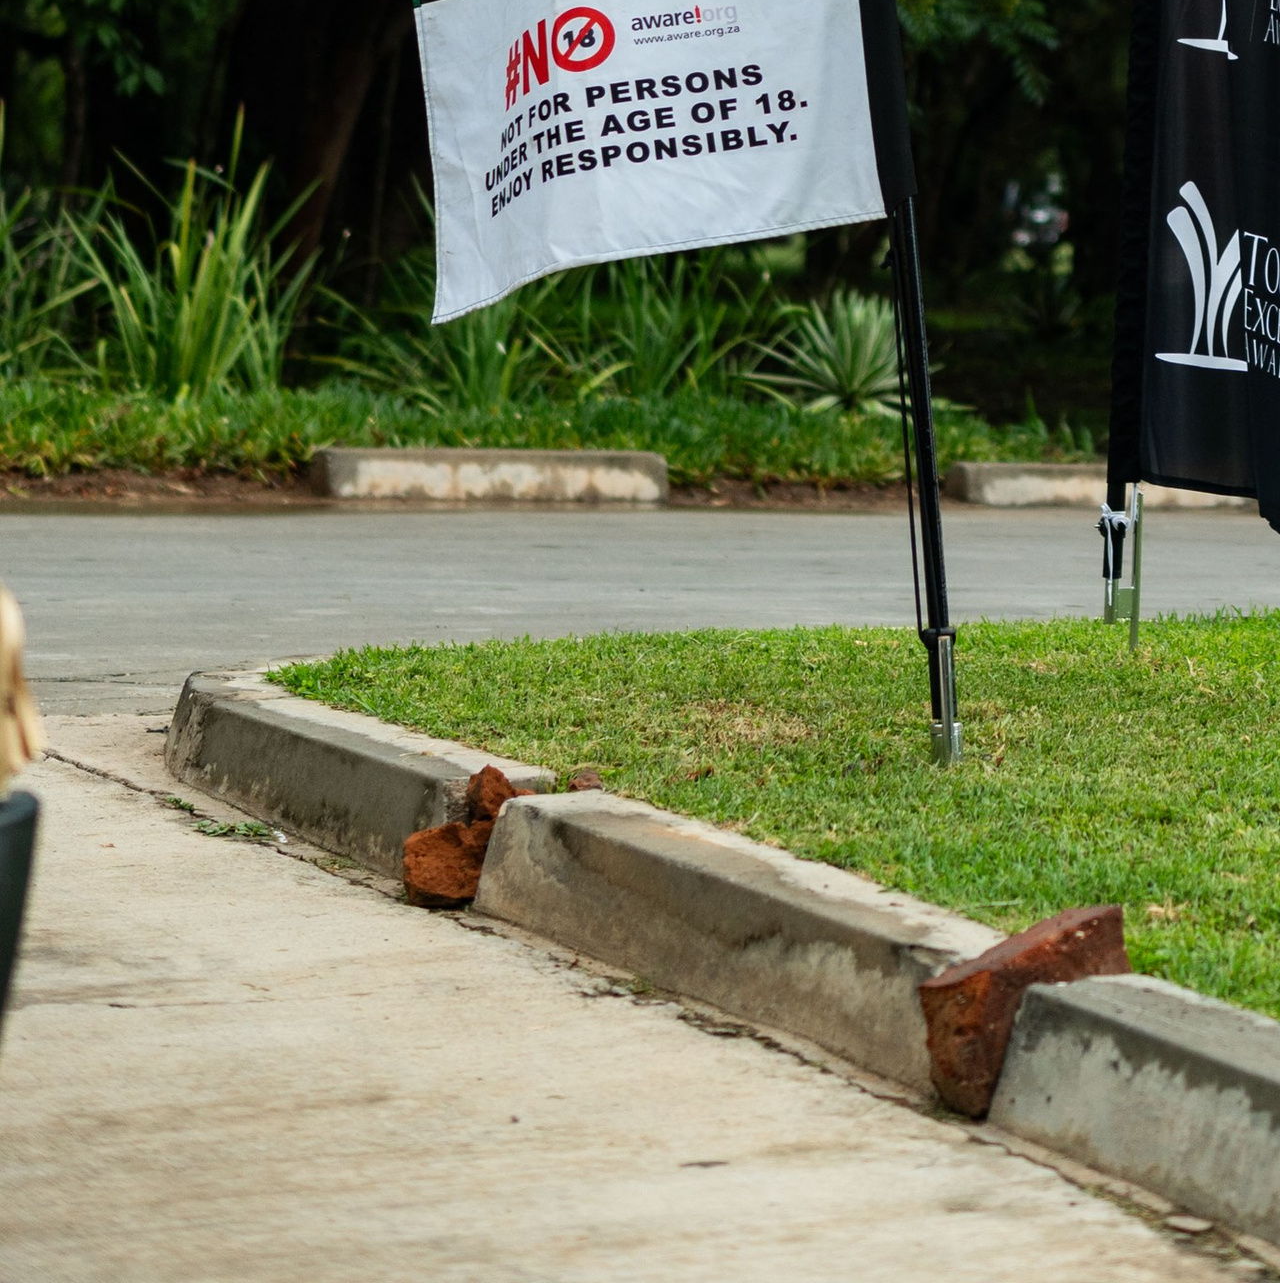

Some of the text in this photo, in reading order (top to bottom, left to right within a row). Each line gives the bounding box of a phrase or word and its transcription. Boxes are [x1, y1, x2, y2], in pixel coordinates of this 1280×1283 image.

[633, 25, 740, 45] www.aware.org.za
[485, 89, 808, 191] UNDER THE AGE OF 18.
[500, 64, 764, 153] NOT FOR PERSONS
[491, 120, 798, 218] ENJOY RESPONSIBLY.
